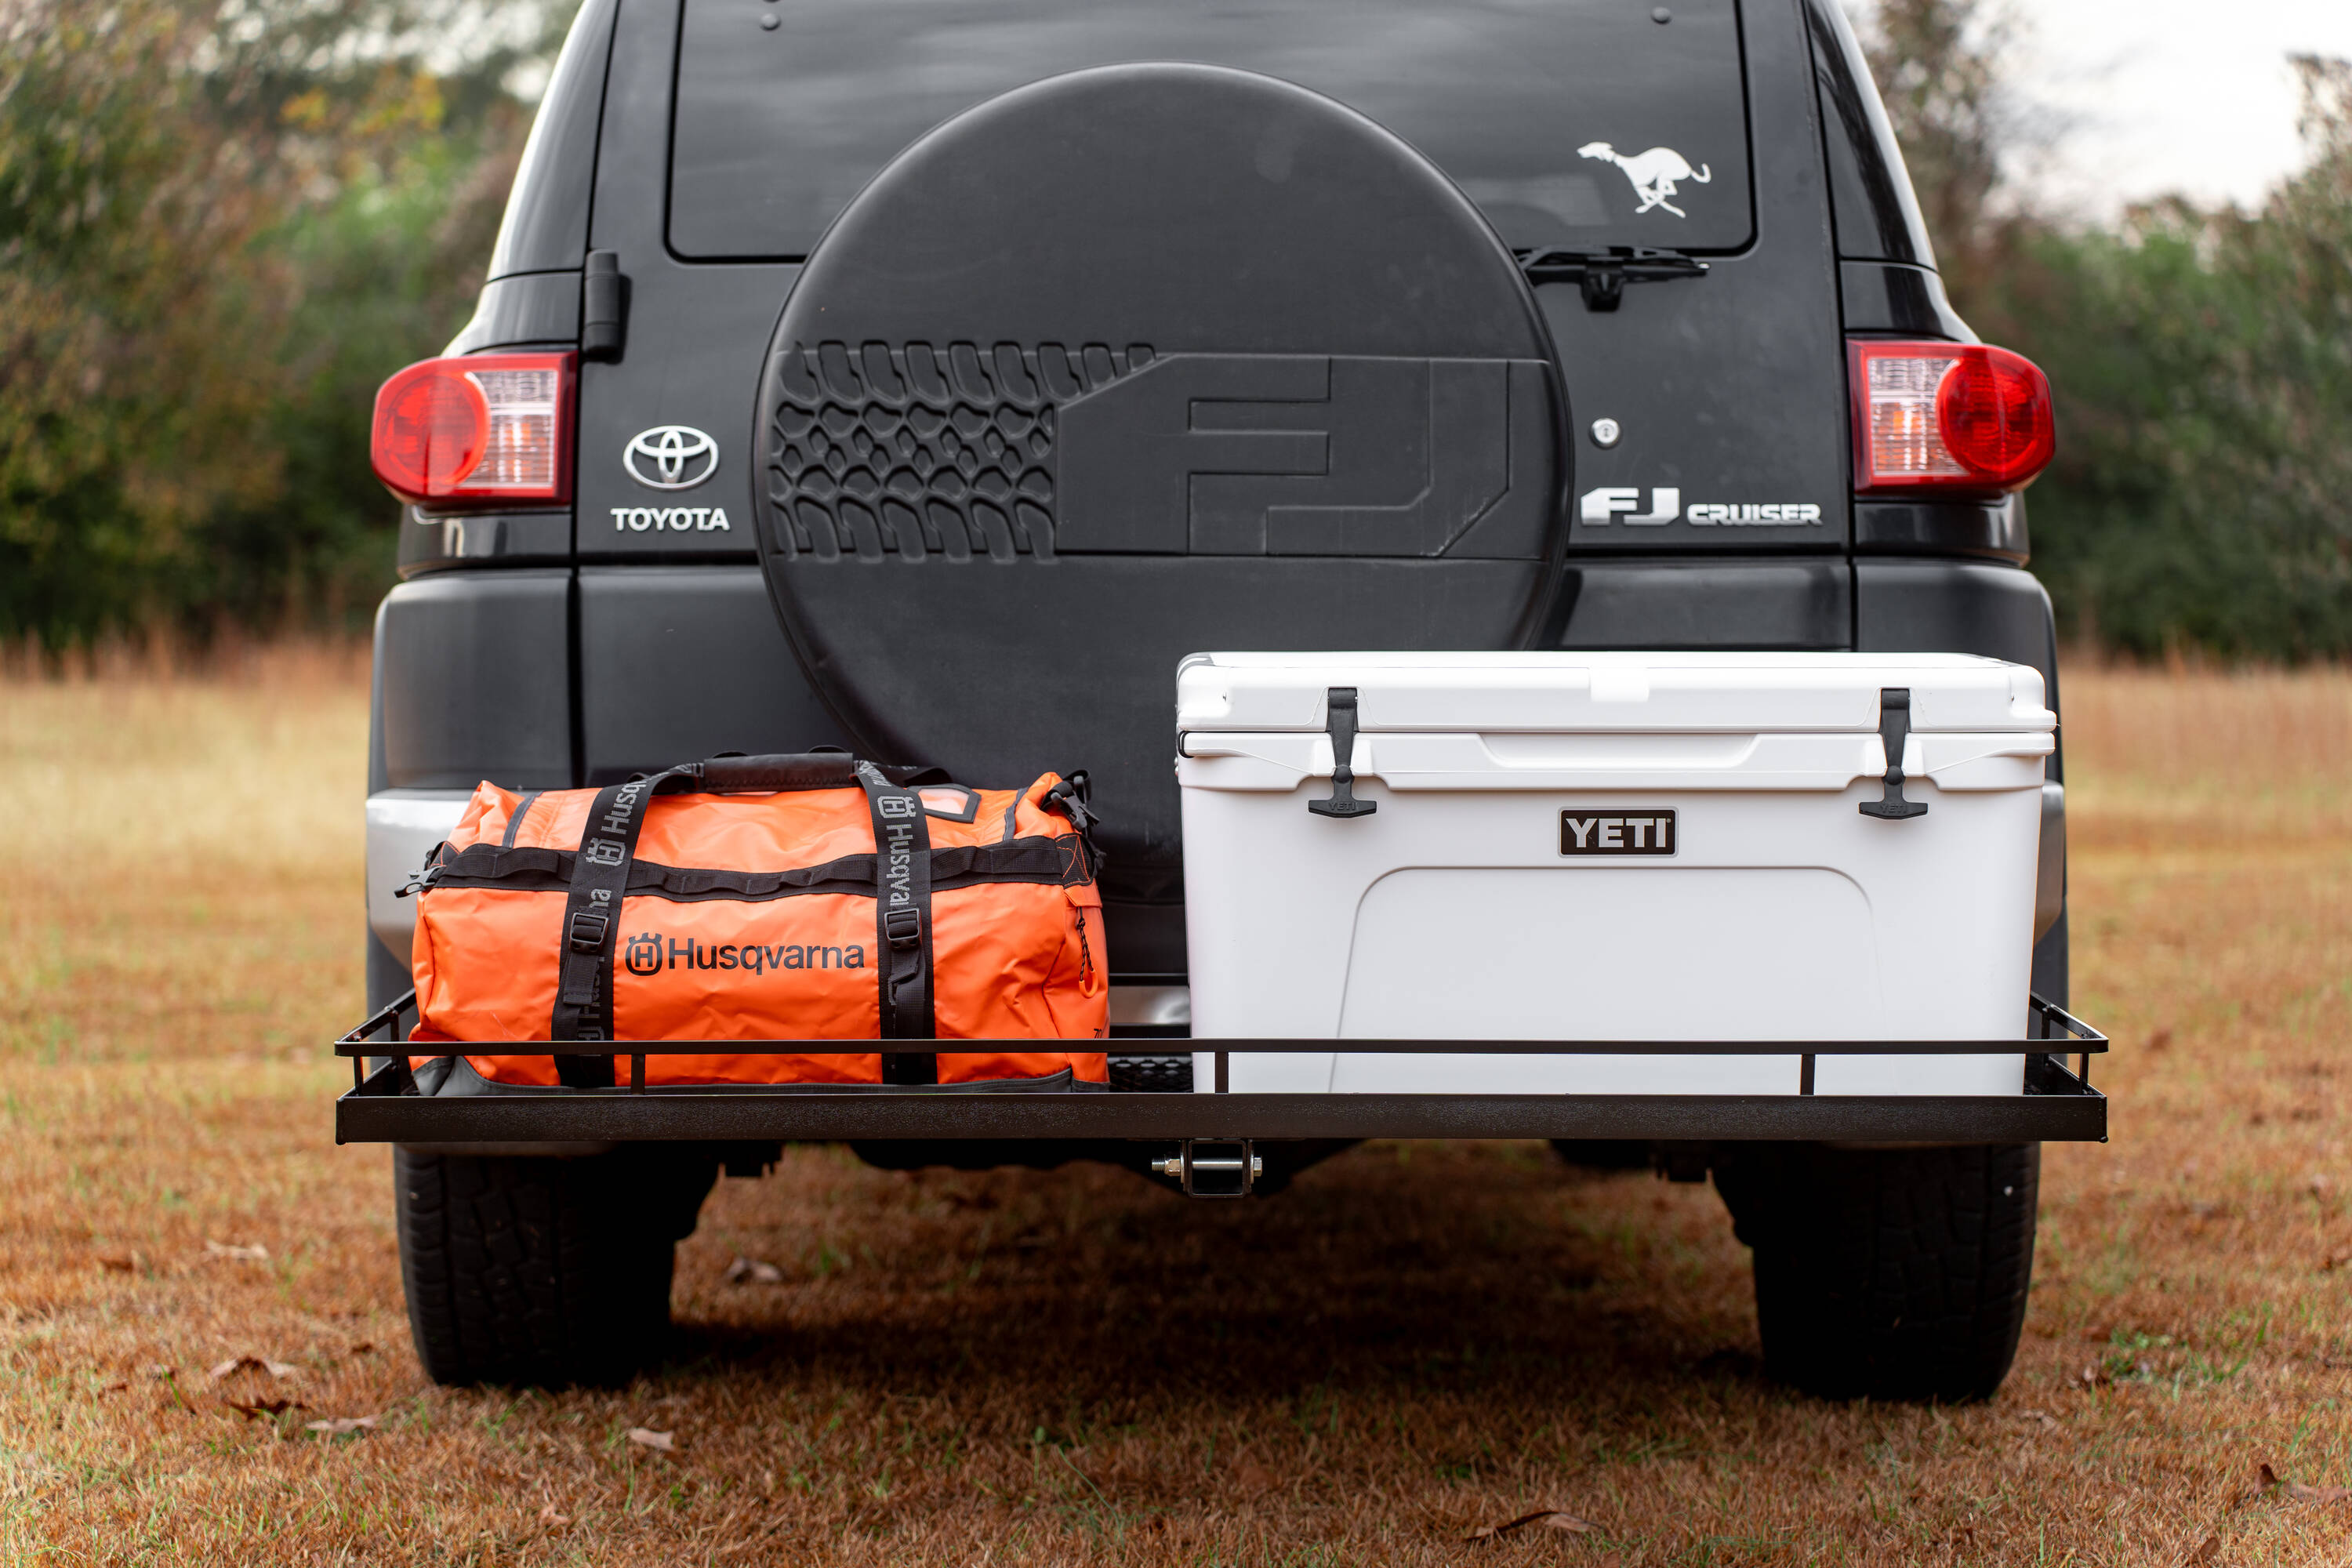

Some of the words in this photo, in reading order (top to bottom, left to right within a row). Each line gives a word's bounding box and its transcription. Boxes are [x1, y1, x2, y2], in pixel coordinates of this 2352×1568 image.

[610, 506, 731, 532] TOYOTA
[1581, 487, 1680, 526] FJ
[1687, 503, 1824, 527] CRUISER
[1328, 801, 1358, 811] YETI
[1565, 818, 1667, 848] YETI
[885, 824, 913, 906] Husqva
[669, 938, 865, 975] Husqvarna
